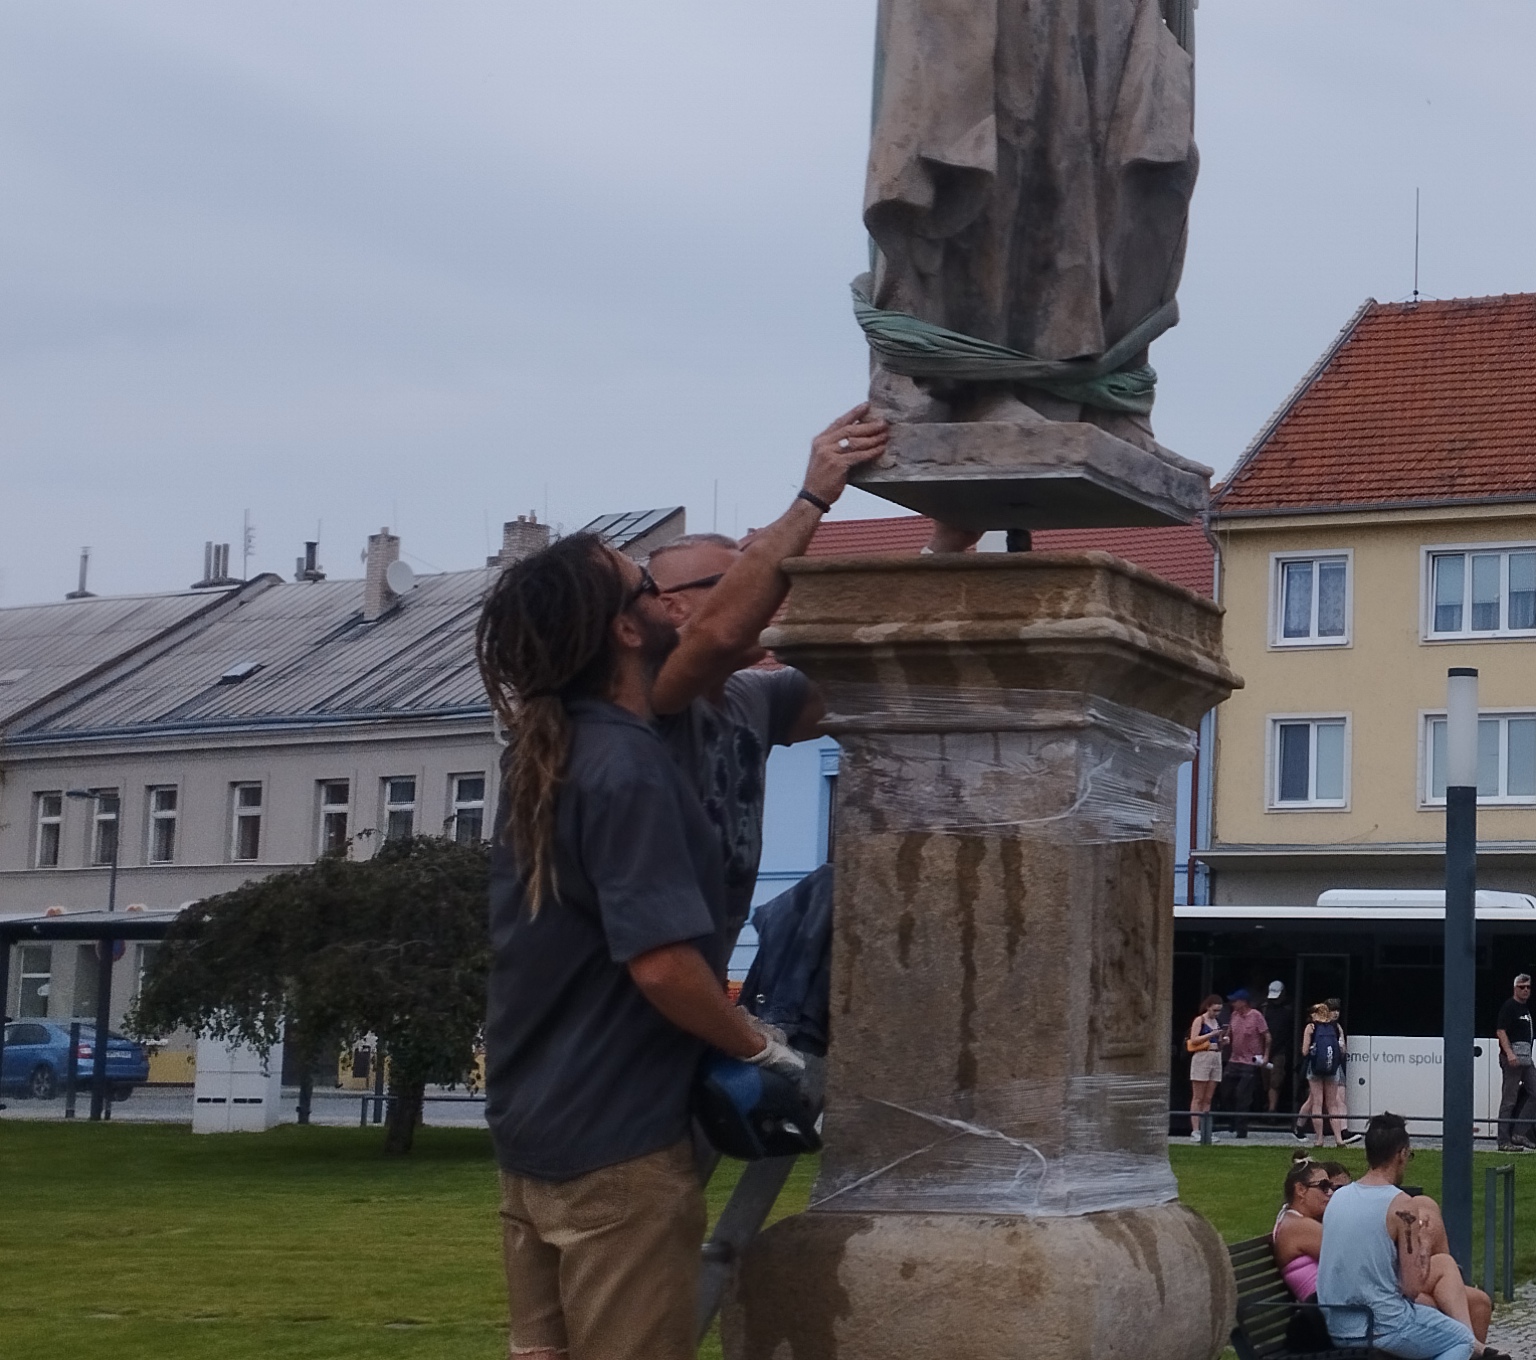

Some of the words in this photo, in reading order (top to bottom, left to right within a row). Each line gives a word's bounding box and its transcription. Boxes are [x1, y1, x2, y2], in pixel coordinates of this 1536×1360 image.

[1372, 1054, 1380, 1062] v
[1383, 1051, 1405, 1064] tom
[1409, 1052, 1442, 1066] spolu
